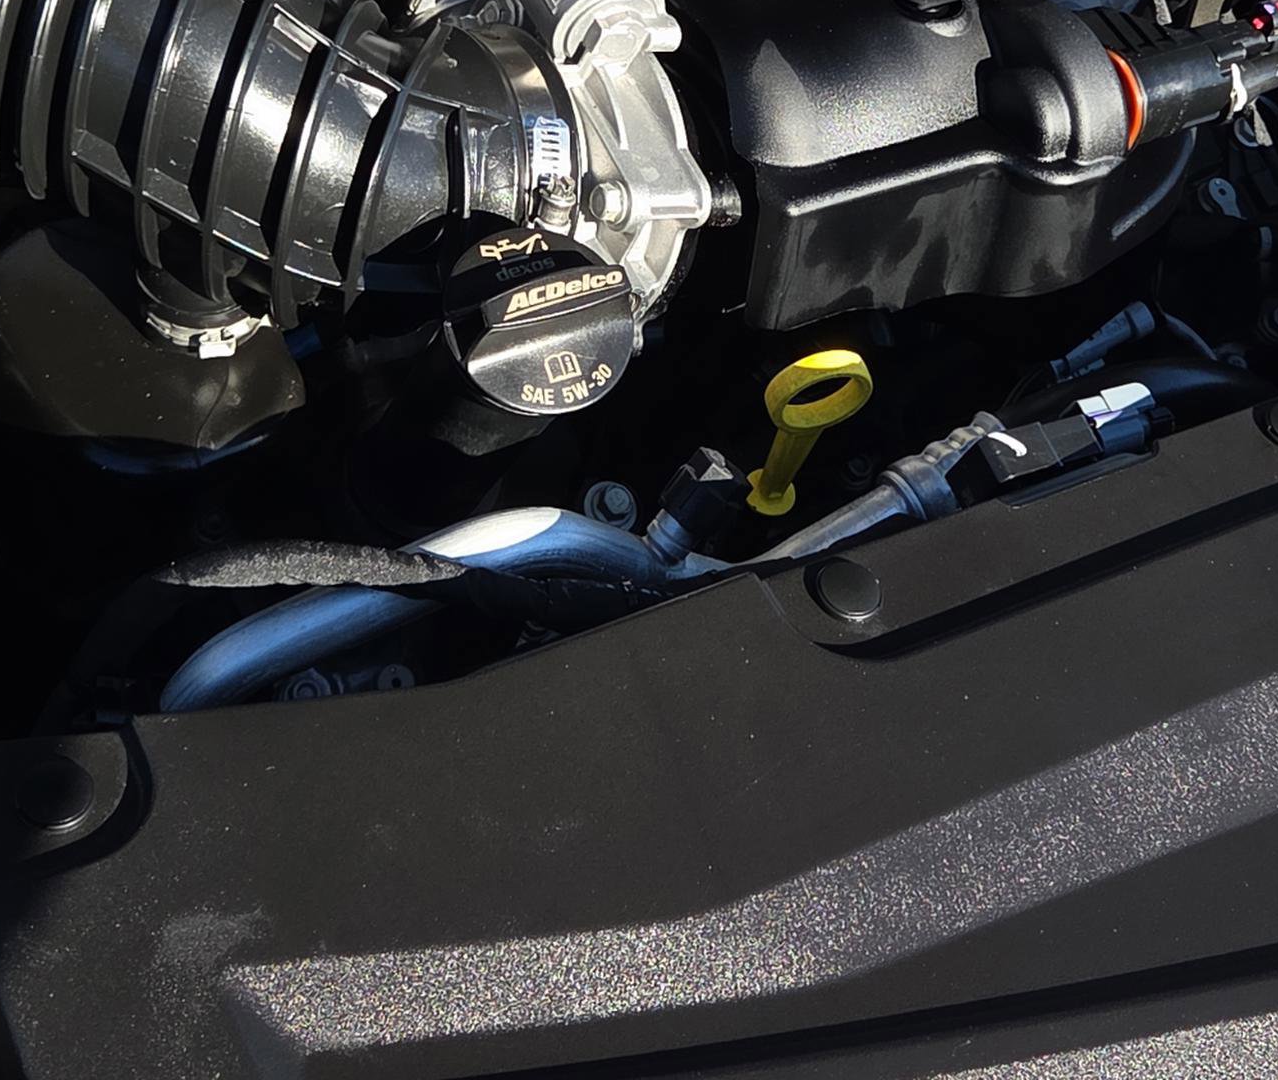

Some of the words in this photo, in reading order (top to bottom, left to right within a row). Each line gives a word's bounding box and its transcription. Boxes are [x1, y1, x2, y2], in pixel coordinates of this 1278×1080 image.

[495, 256, 556, 282] dexos
[506, 270, 623, 314] ACDelco
[521, 383, 555, 406] SAE
[563, 363, 613, 404] 5W-30
